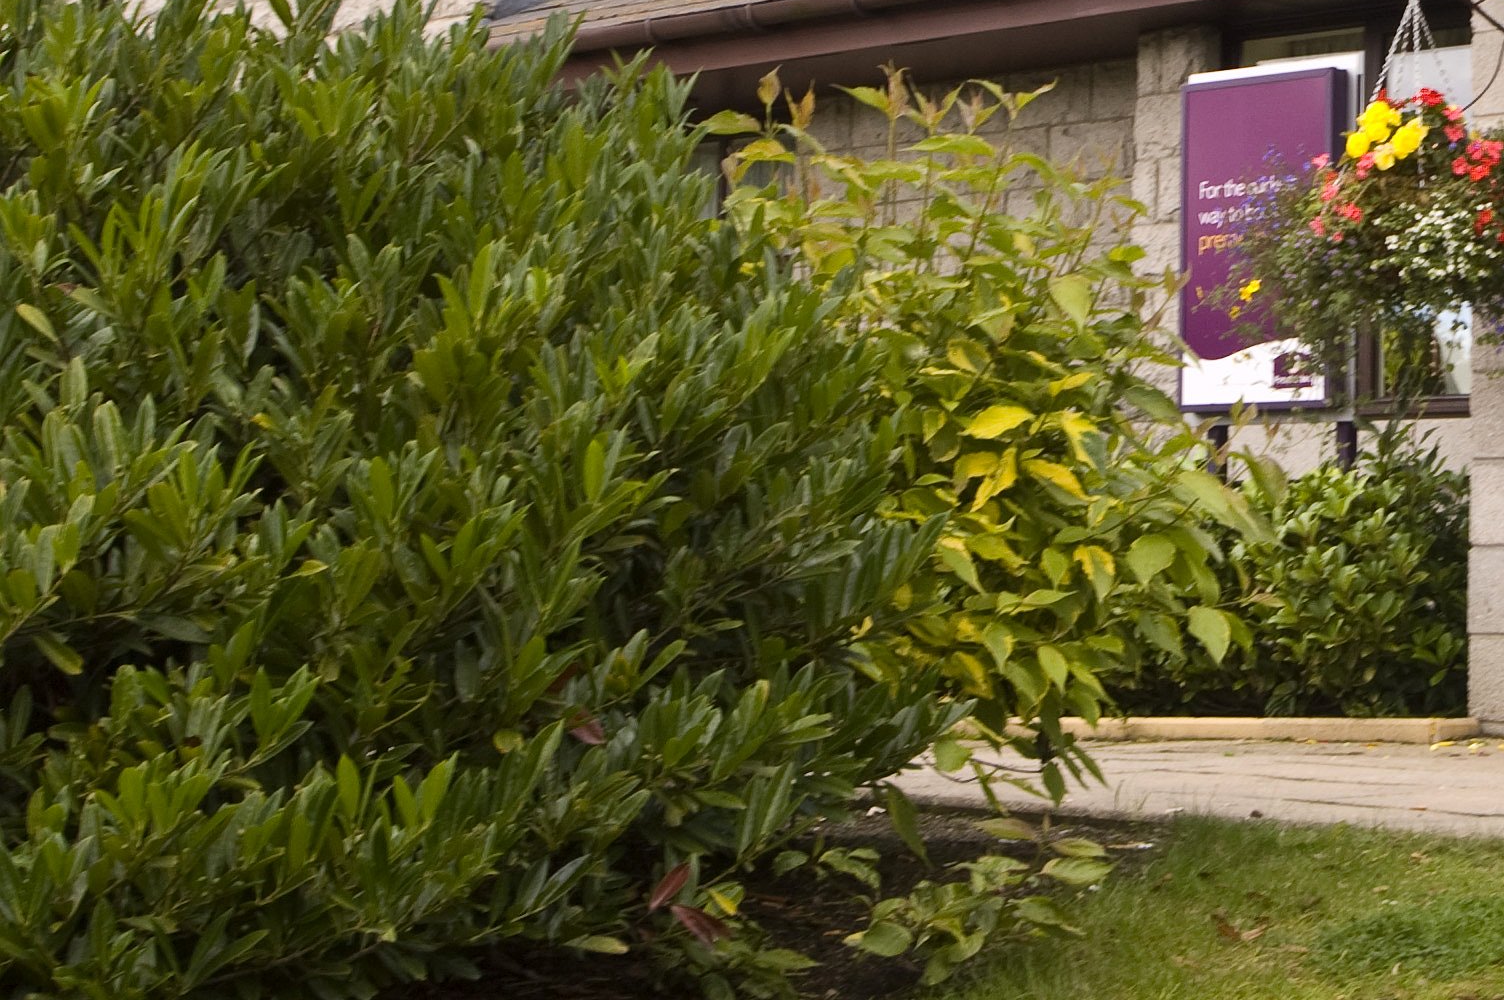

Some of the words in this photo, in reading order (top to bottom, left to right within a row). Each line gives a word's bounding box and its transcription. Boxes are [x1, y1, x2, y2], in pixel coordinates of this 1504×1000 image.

[1199, 180, 1223, 200] For
[1224, 178, 1246, 198] the
[1198, 210, 1226, 229] way
